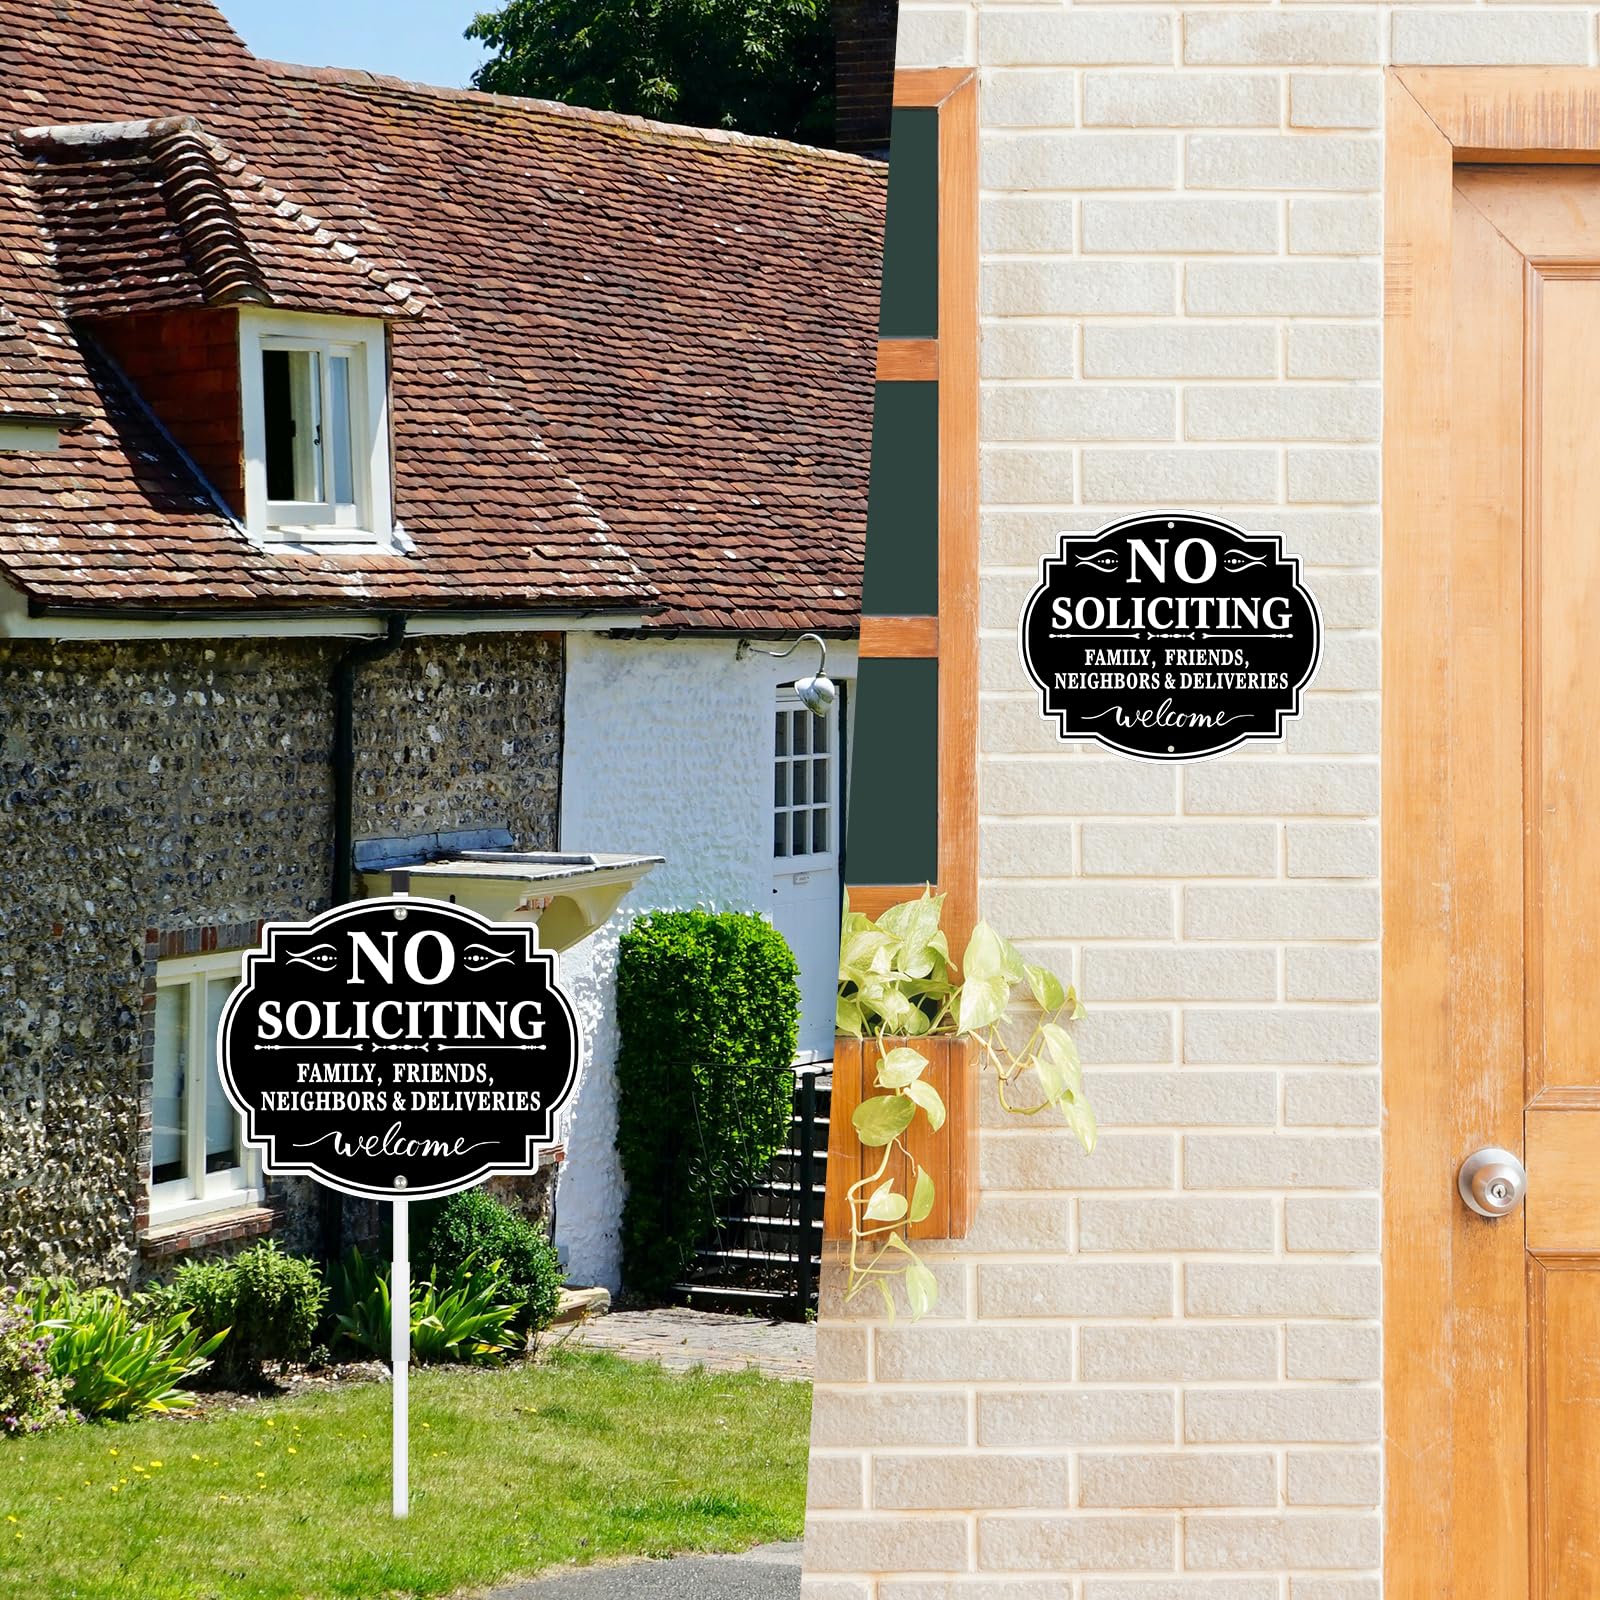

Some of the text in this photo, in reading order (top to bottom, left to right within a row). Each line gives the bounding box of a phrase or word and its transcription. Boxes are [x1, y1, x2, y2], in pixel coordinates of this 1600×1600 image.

[1125, 537, 1217, 584] NO
[1051, 596, 1293, 630] SOLICITING
[1084, 648, 1250, 669] FAMILY, FRIENDS,
[1054, 672, 1289, 690] NEIGHBORS & DELIVERIES
[1081, 697, 1255, 728] welcome
[346, 930, 456, 986] NO
[257, 1000, 546, 1040] SOLICITING
[296, 1063, 494, 1087] FAMILY, FRIENDS,
[260, 1090, 541, 1112] NEIGHBORS & DELIVERIES
[293, 1120, 500, 1158] welcome
